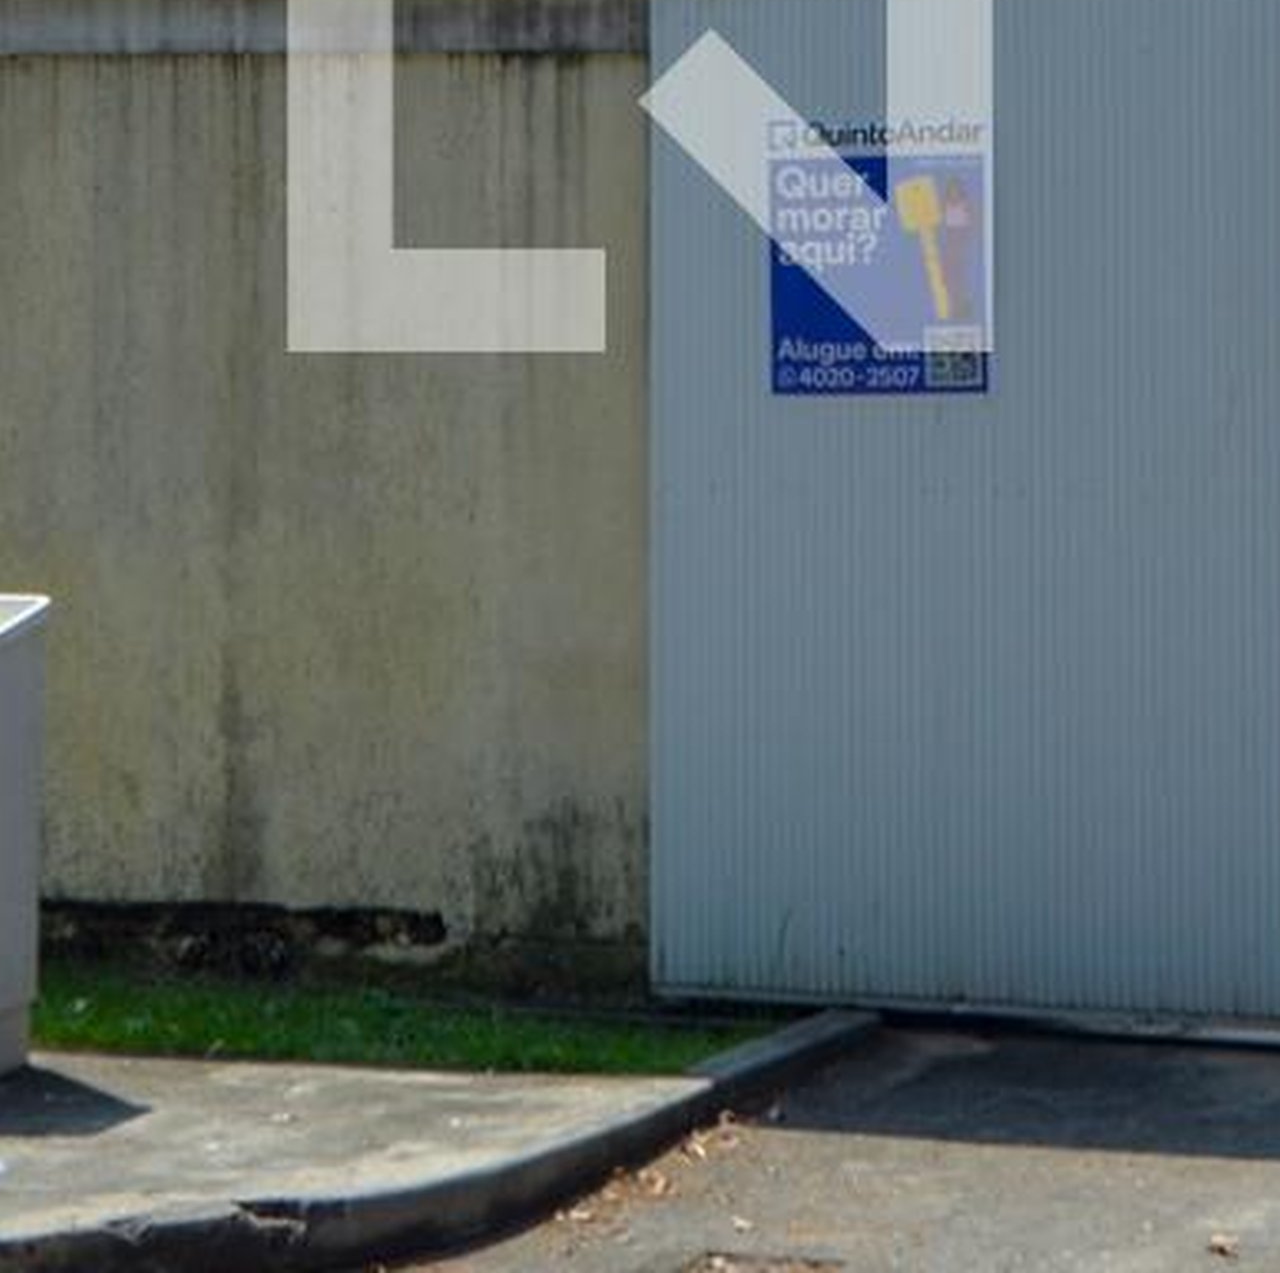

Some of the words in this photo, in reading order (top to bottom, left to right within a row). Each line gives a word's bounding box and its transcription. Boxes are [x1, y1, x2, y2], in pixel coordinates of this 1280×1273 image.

[802, 119, 980, 148] QuintoAndar
[776, 164, 868, 200] Quer
[776, 206, 887, 231] morar
[778, 234, 878, 271] aqui?
[777, 337, 868, 367] Alugue
